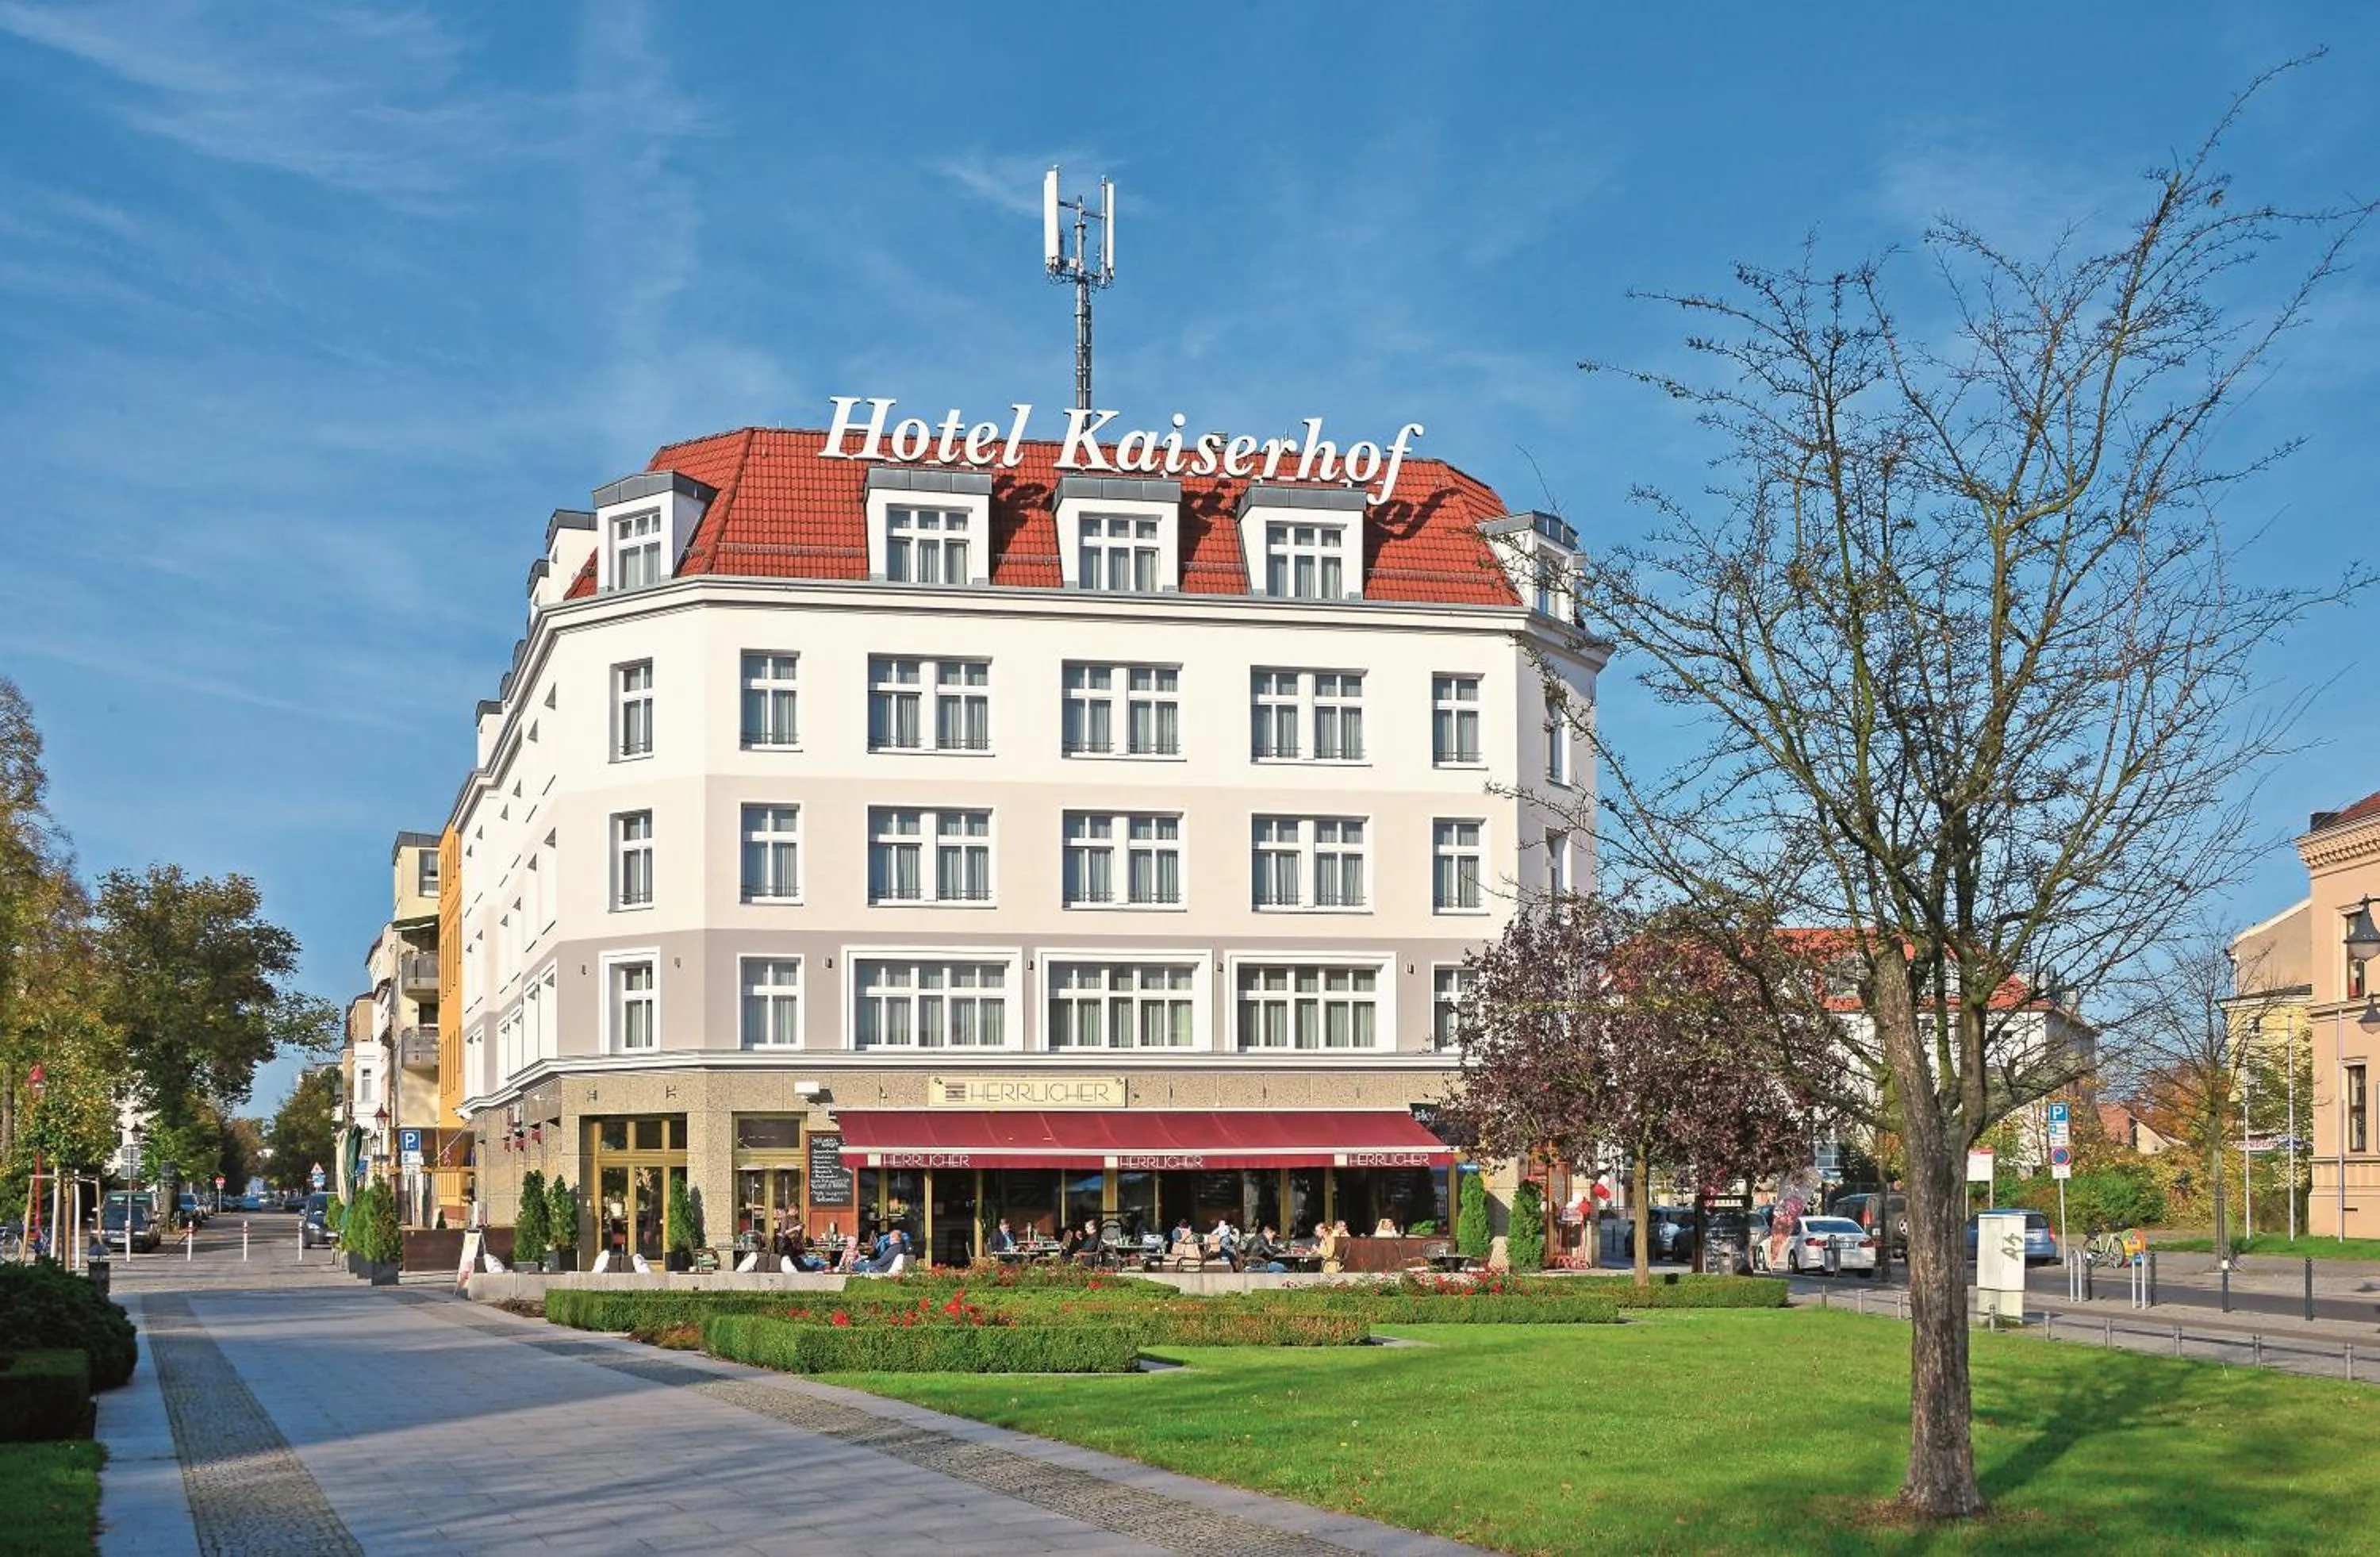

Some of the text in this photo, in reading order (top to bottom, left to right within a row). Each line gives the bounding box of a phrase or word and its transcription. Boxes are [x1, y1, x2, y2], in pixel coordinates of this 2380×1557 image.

[818, 396, 1424, 505] Hotel Kaiserhof
[970, 1082, 1110, 1102] HERRLICHER
[2052, 1105, 2064, 1120] P
[405, 1132, 416, 1150] P
[882, 1153, 970, 1167] HERRLICHER
[1119, 1155, 1204, 1169] HERRLICHER
[1349, 1153, 1430, 1167] HERRLICHER
